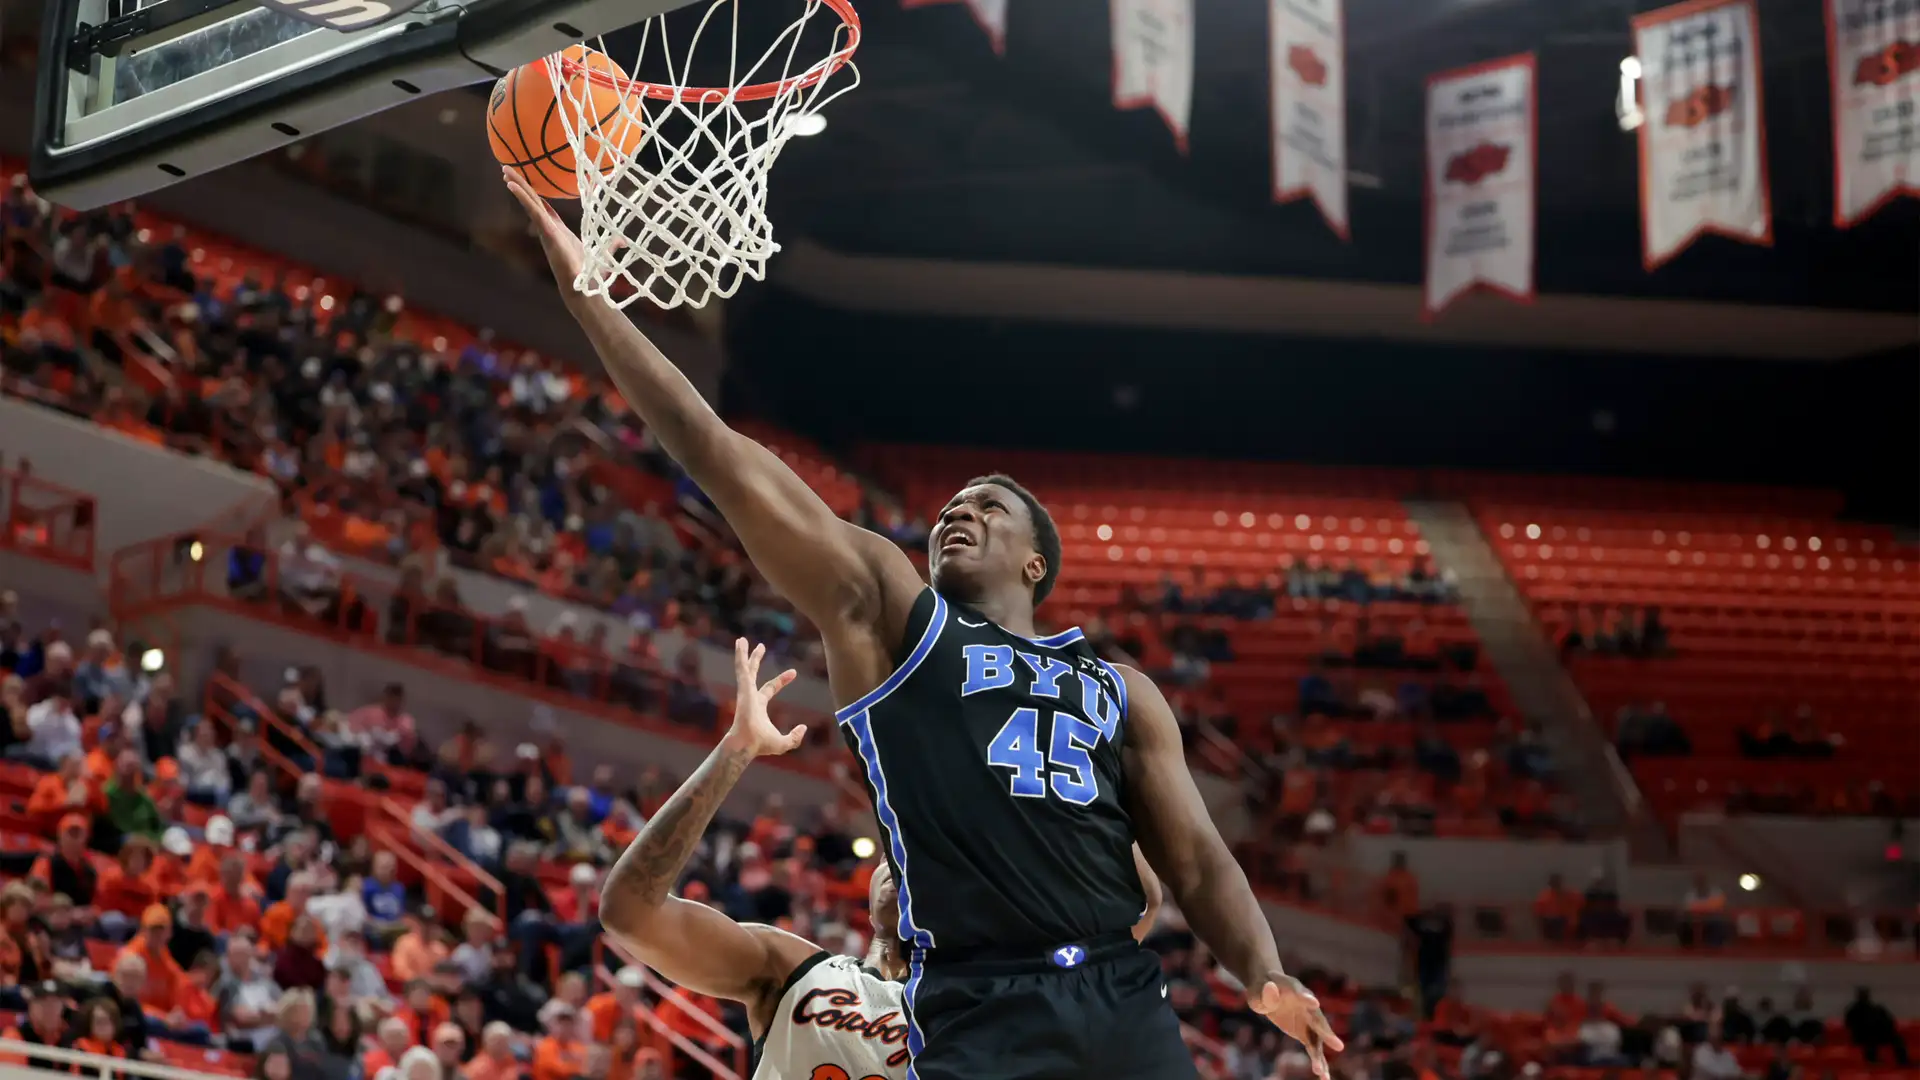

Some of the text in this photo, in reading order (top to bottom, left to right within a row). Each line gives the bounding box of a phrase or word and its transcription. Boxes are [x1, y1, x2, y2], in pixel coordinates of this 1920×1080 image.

[961, 644, 1121, 742] BYU
[987, 707, 1102, 806] 45
[1057, 947, 1079, 966] Y
